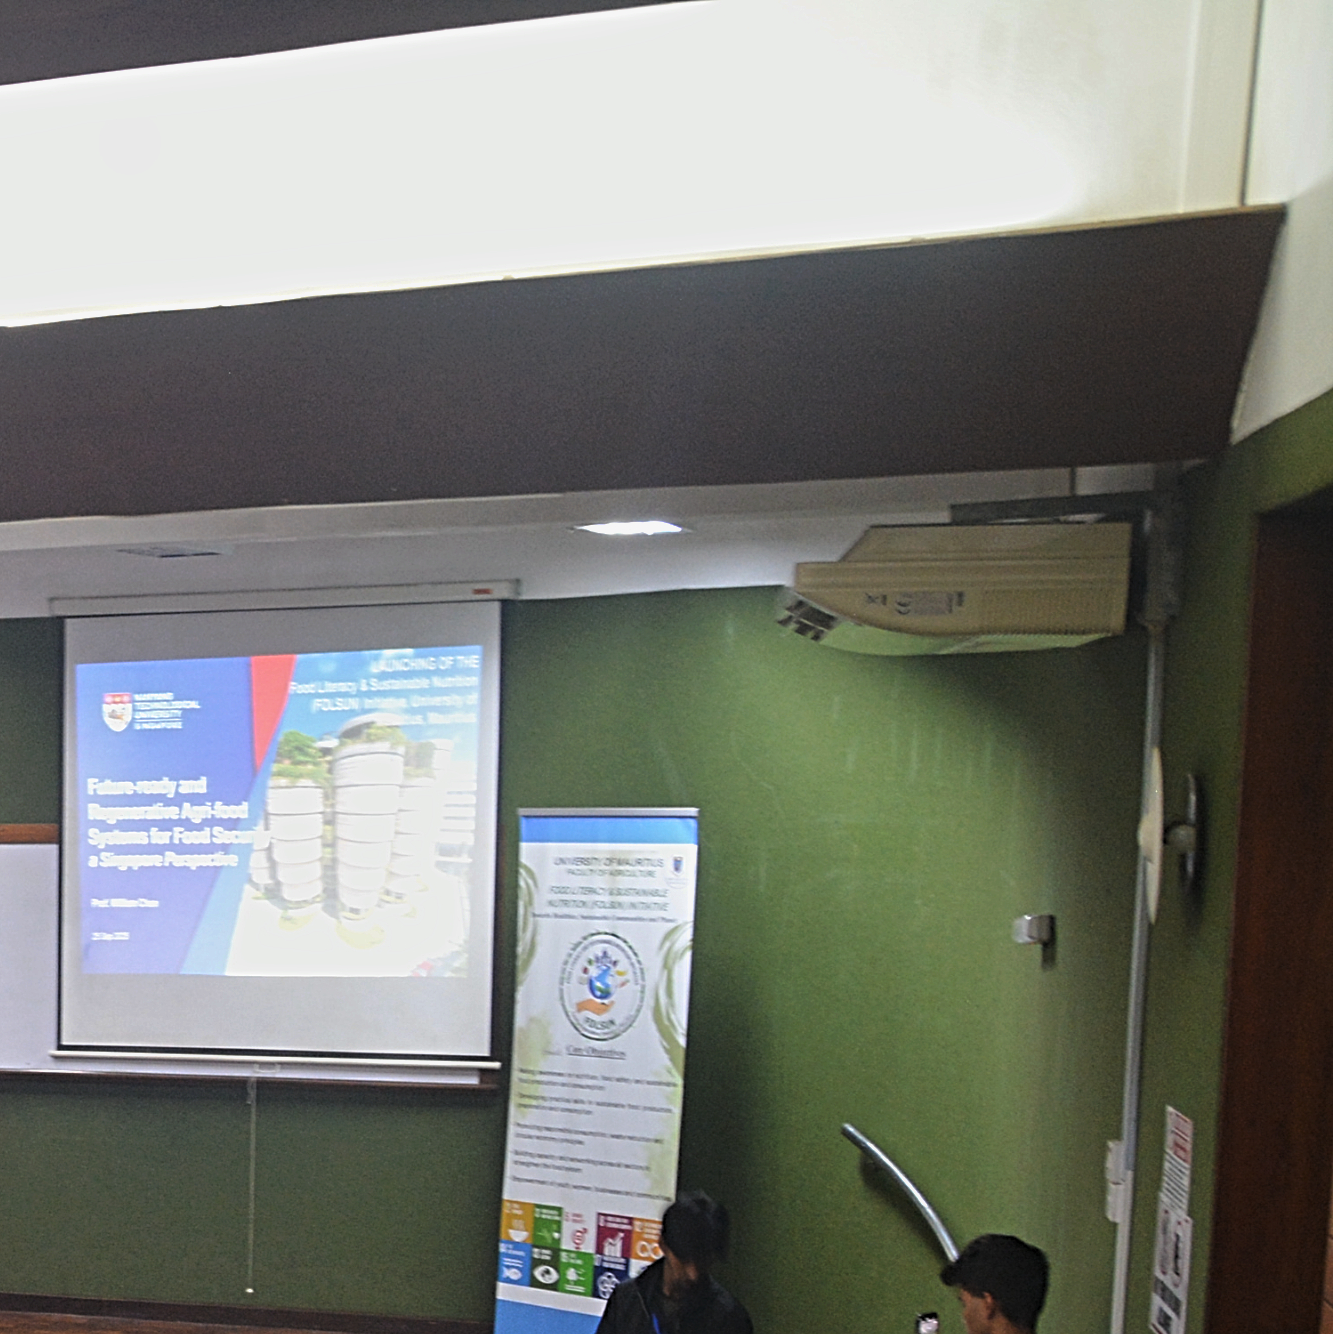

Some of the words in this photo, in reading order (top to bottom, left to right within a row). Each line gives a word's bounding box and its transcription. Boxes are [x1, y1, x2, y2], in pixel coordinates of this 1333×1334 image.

[438, 656, 454, 669] OF
[456, 655, 480, 668] THE
[290, 680, 316, 694] Food
[87, 777, 177, 798] Future-ready
[178, 776, 208, 793] and
[181, 801, 249, 823] Agri-food
[87, 828, 149, 848] Systems
[149, 827, 172, 844] for
[172, 827, 211, 844] Food
[87, 855, 99, 867] a
